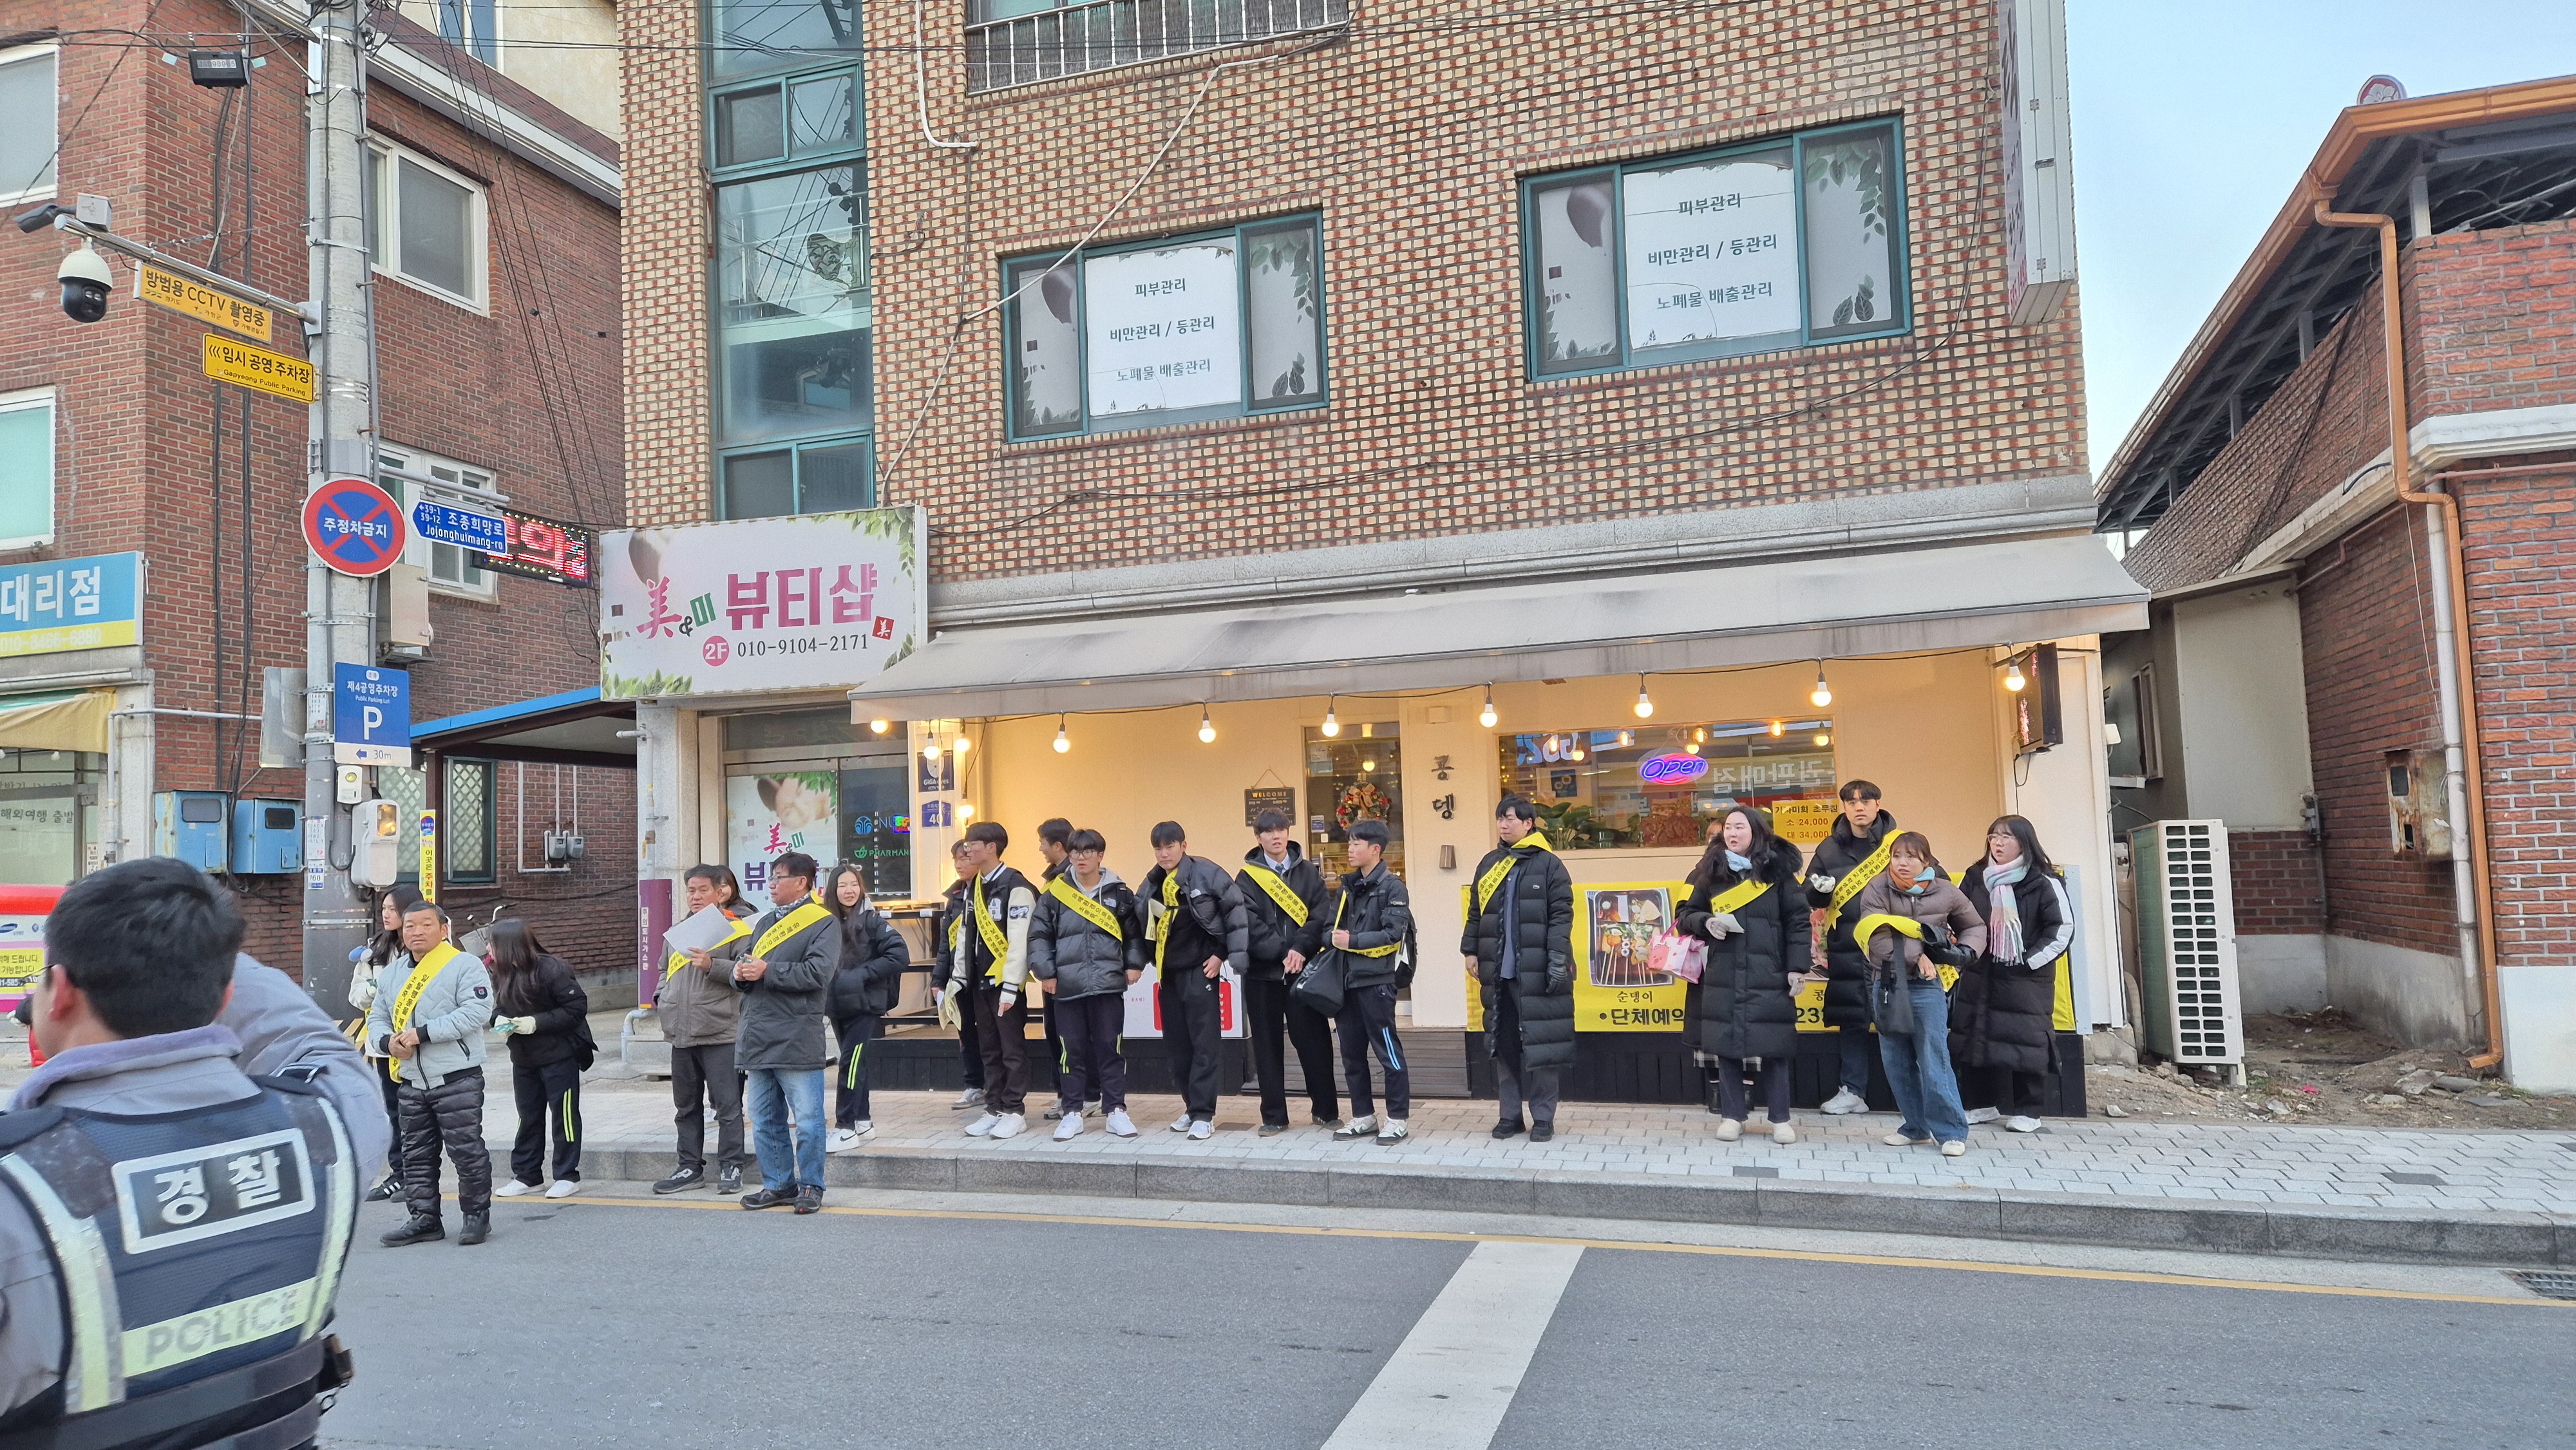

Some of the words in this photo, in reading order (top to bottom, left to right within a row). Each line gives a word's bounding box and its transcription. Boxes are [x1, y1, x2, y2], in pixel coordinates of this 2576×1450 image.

[1679, 193, 1741, 216] 피부관리
[1648, 243, 1710, 267] 비만관리
[1730, 234, 1777, 256] 등관리
[146, 270, 184, 297] 방범용
[187, 287, 226, 311] CCTV
[229, 300, 265, 327] 촬영중
[1135, 278, 1186, 297] 피부관리
[1657, 291, 1703, 309] 노폐물
[1709, 281, 1772, 304] 배출관리
[1110, 323, 1160, 343] 비만관리
[1177, 315, 1215, 335] 등관리
[223, 346, 246, 367] 임시
[249, 353, 272, 373] 공영
[275, 361, 310, 384] 주차장
[1117, 366, 1155, 382] 노폐물
[1159, 359, 1211, 377] 배출관리
[223, 369, 258, 384] Gapyeong
[260, 378, 279, 389] Public
[281, 384, 306, 396] Parking
[420, 513, 440, 524] 39-12
[424, 504, 440, 516] 39-1
[323, 517, 387, 538] 주정차금지
[448, 512, 504, 536] 조종희망로
[426, 524, 503, 551] Jojonghuimang-ro
[1, 566, 100, 622] 대리점
[726, 563, 877, 630] 뷰티샵
[705, 643, 728, 660] 2F
[737, 634, 868, 657] 010-9104-2171
[347, 681, 398, 697] 제4공영주차장
[363, 706, 383, 740] P
[374, 750, 392, 760] 30m
[1643, 758, 1706, 779] Open
[1, 808, 47, 823] 해외여행
[1799, 818, 1828, 826] 24,000
[1799, 830, 1829, 839] 34,000
[1617, 991, 1653, 1003] 순뎅이
[155, 1147, 281, 1225] 경찰
[146, 1288, 299, 1366] POLICE
